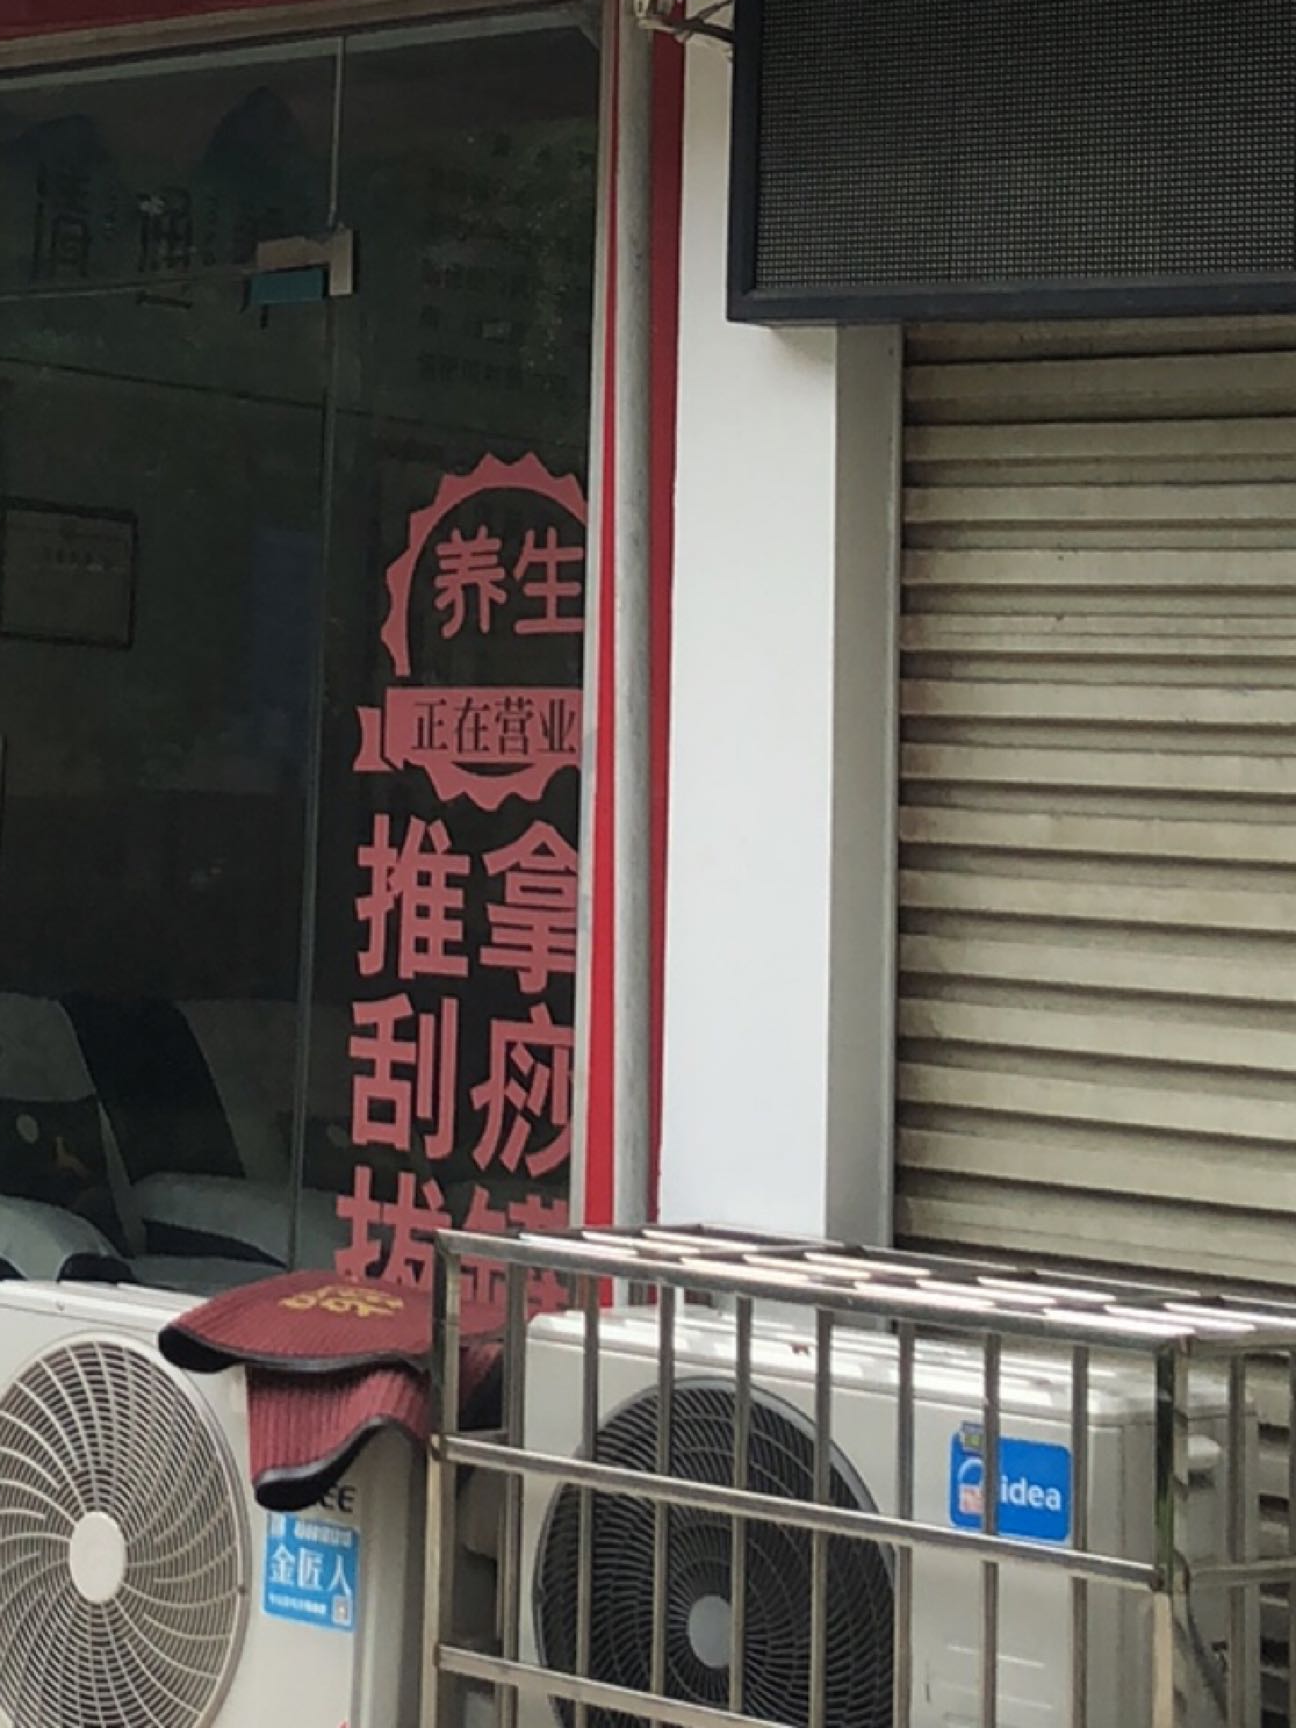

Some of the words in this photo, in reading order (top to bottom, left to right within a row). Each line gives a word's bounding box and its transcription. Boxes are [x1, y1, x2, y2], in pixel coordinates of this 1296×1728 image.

[433, 525, 585, 640] 养生
[411, 696, 577, 755] 正在营业
[355, 813, 578, 994] 推拿
[349, 993, 575, 1178] 刮痧
[1000, 1474, 1062, 1512] idea
[269, 1542, 353, 1597] 金匠人
